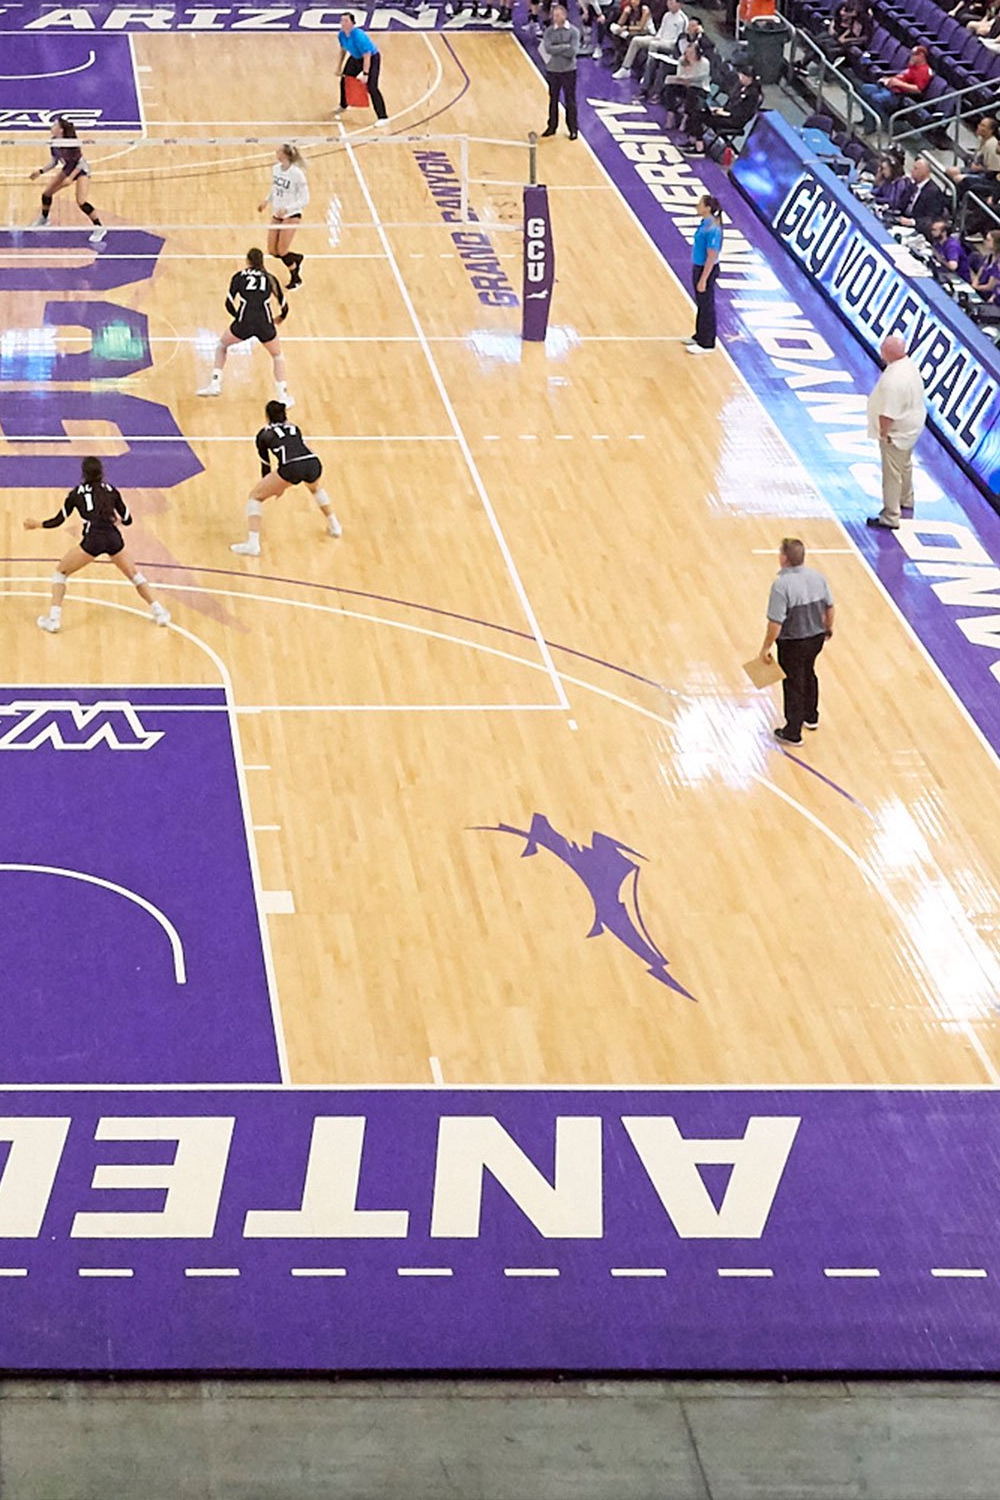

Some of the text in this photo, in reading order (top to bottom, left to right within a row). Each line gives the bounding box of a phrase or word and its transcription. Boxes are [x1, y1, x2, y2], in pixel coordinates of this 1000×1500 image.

[23, 8, 513, 30] ARIZONA
[451, 231, 520, 308] GRAND
[527, 218, 546, 282] GCU
[246, 275, 267, 291] 21
[772, 170, 994, 449] GCU VOLLEYBALL
[83, 493, 95, 512] 1
